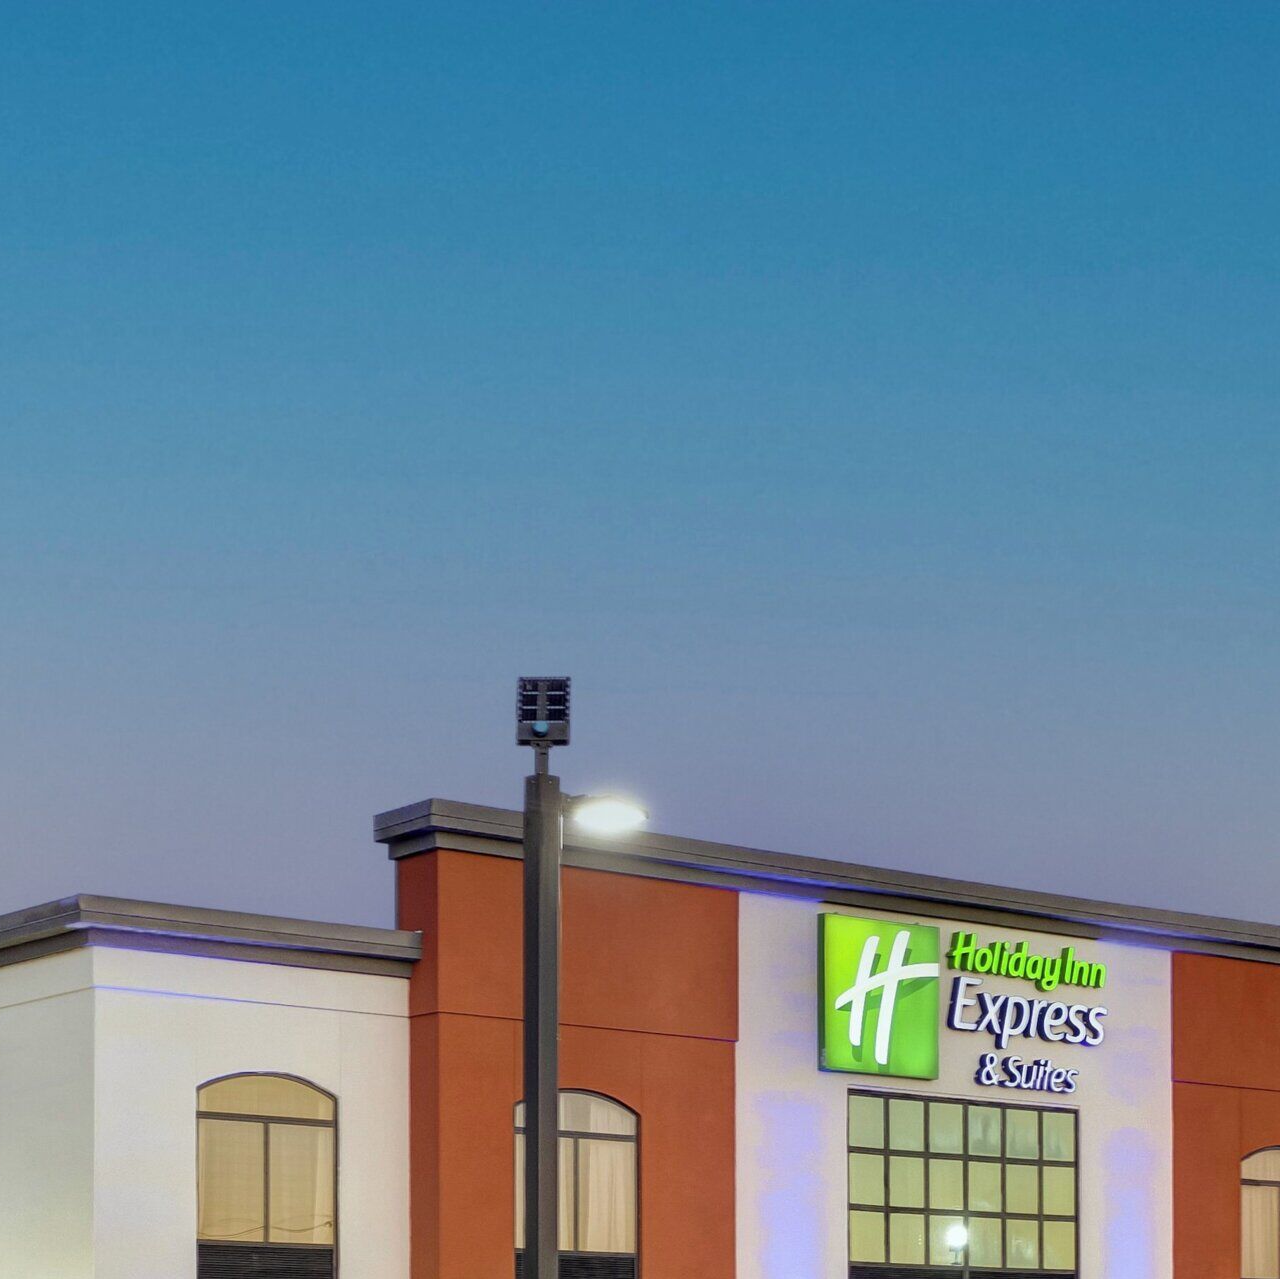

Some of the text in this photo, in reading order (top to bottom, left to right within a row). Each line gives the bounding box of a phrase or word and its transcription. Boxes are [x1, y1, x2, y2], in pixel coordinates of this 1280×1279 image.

[946, 931, 1107, 992] Holiday Inn
[947, 976, 1108, 1050] Express
[974, 1052, 1080, 1094] & Suites
